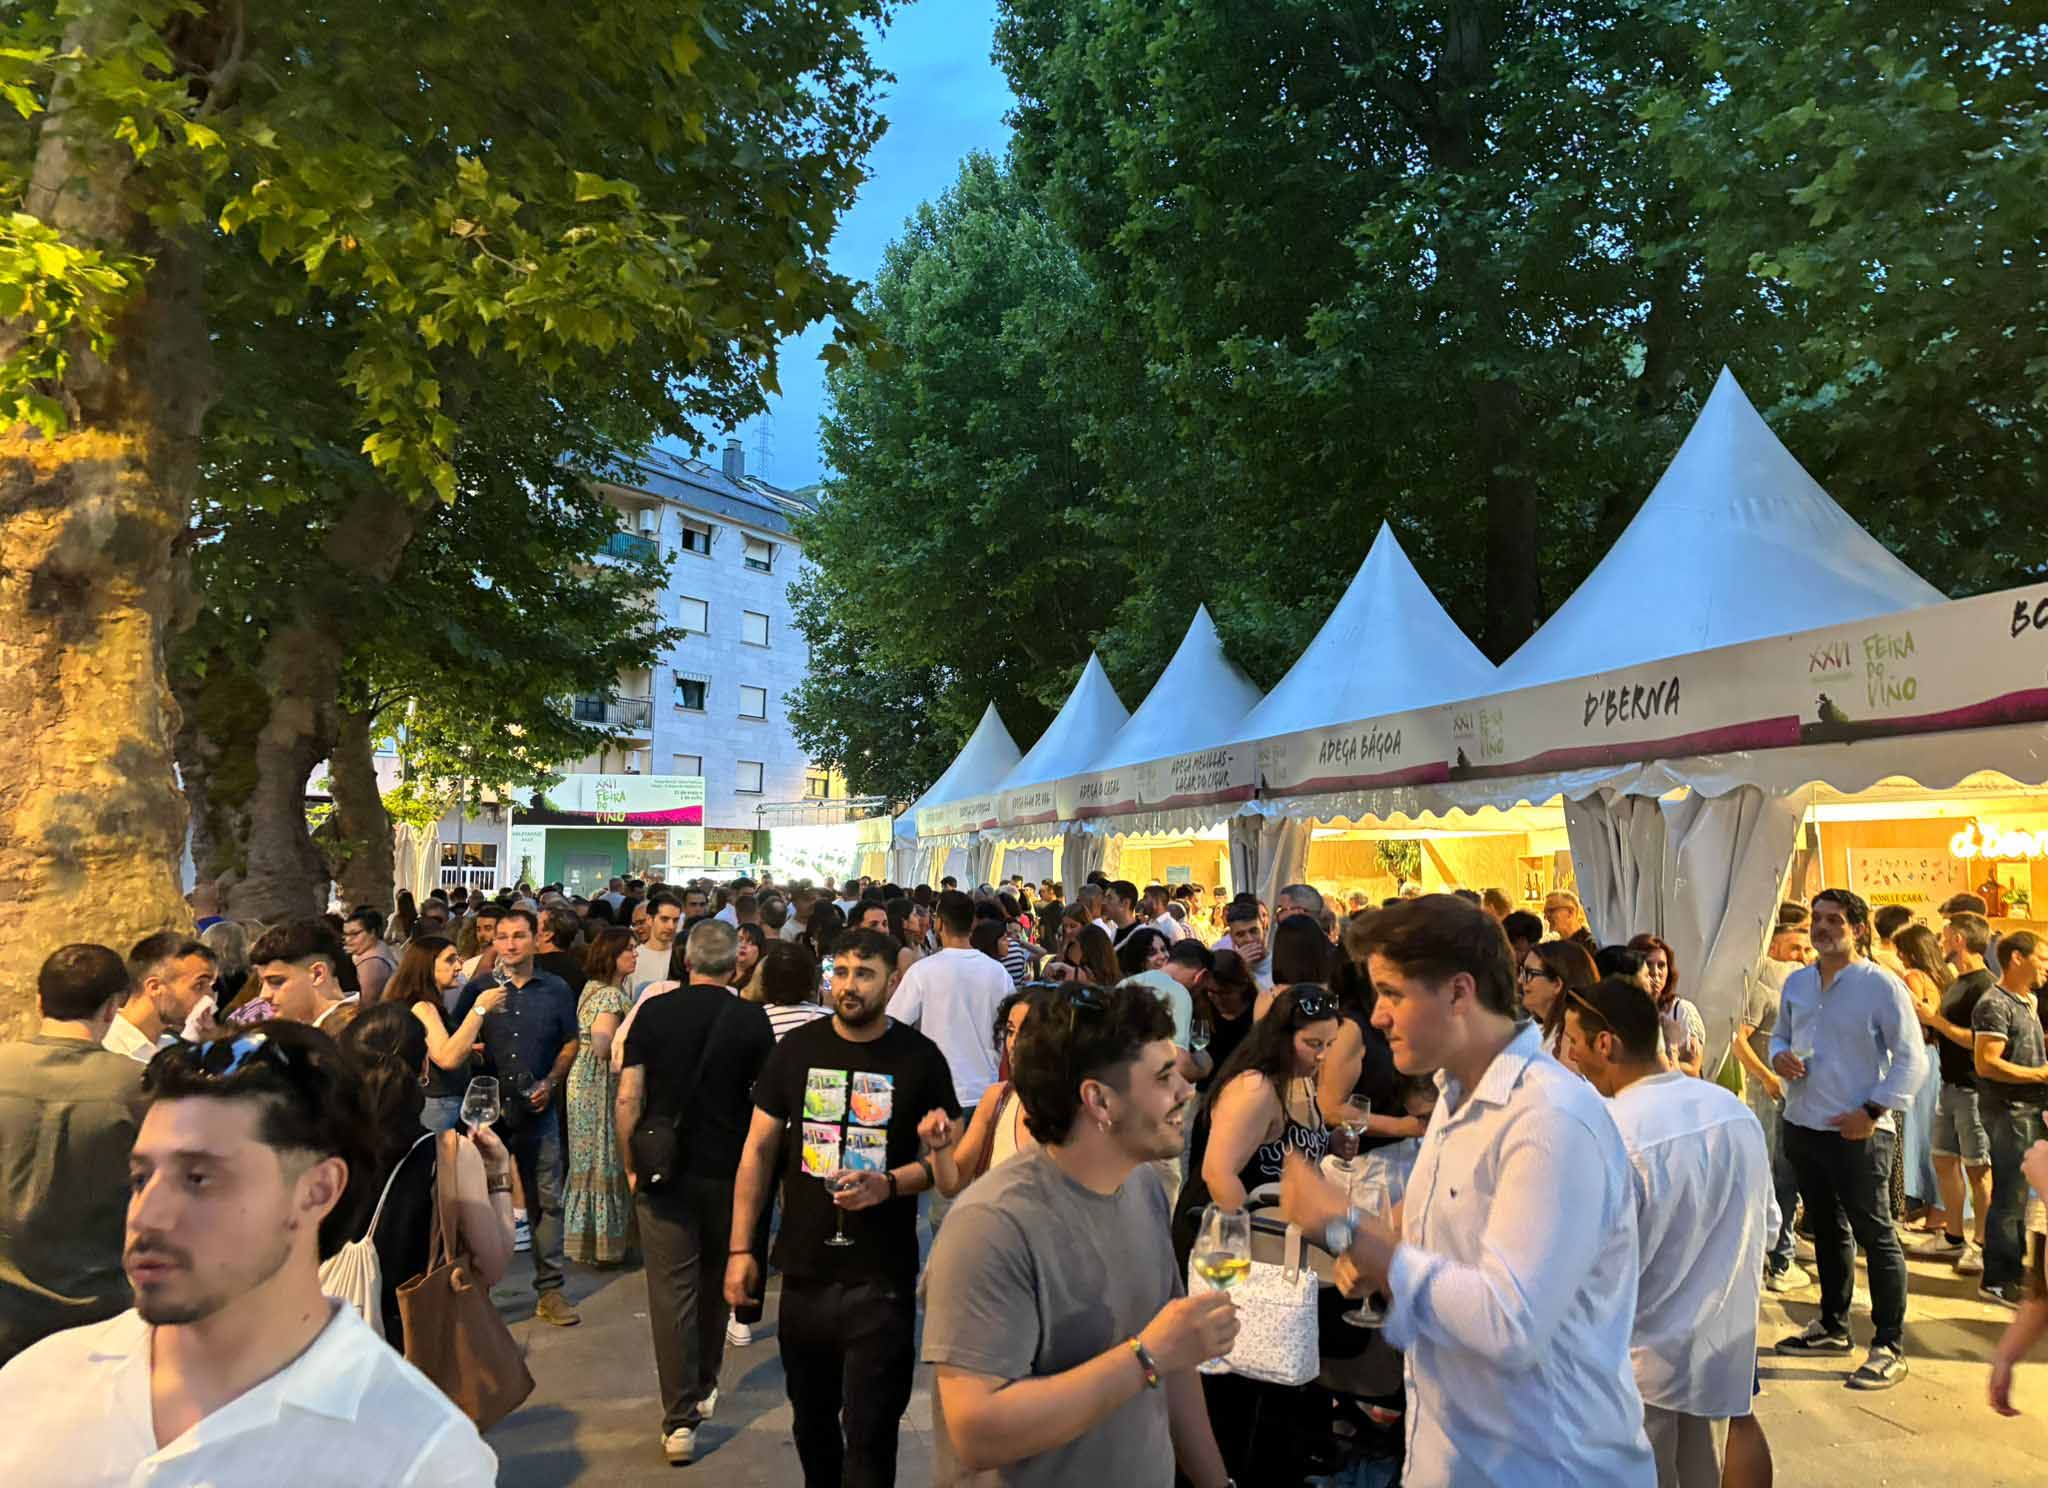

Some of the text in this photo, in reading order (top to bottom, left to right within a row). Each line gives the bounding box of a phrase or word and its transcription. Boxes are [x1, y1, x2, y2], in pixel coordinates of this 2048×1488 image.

[1809, 642, 1851, 673] XXVI
[1862, 631, 1915, 661] FEIRA
[1583, 676, 1681, 727] D'BERNA
[1866, 674, 1918, 708] VIÑO
[1319, 737, 1358, 767] ADEGA
[1360, 725, 1402, 762] BÁGOA
